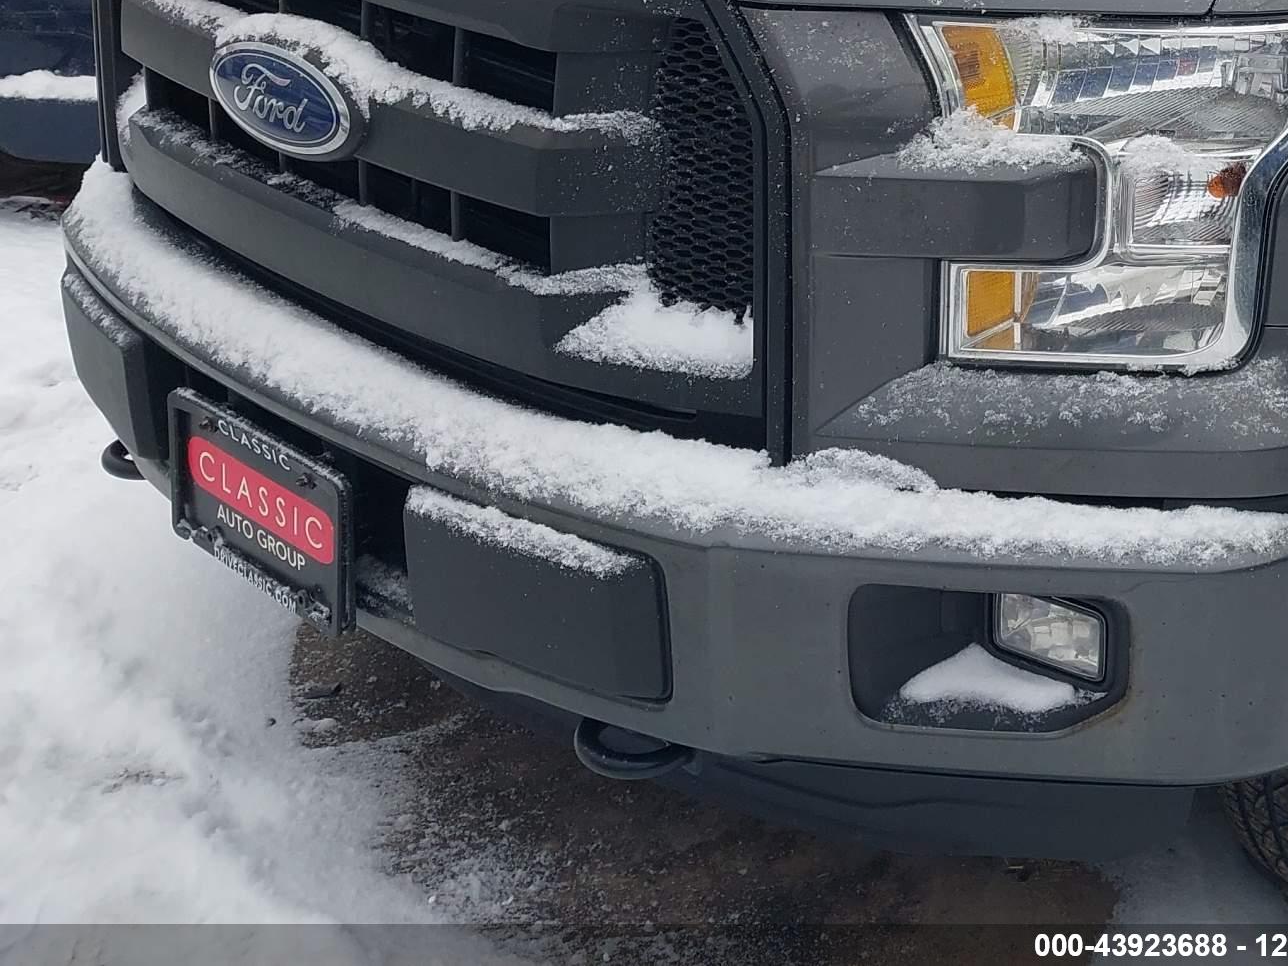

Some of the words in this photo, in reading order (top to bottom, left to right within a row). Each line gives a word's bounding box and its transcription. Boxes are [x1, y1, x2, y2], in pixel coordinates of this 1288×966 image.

[233, 62, 308, 134] Ford
[217, 420, 291, 472] CLASSIC
[199, 450, 324, 550] CLASSIC
[216, 503, 254, 540] AUTO
[256, 529, 307, 571] GROUP
